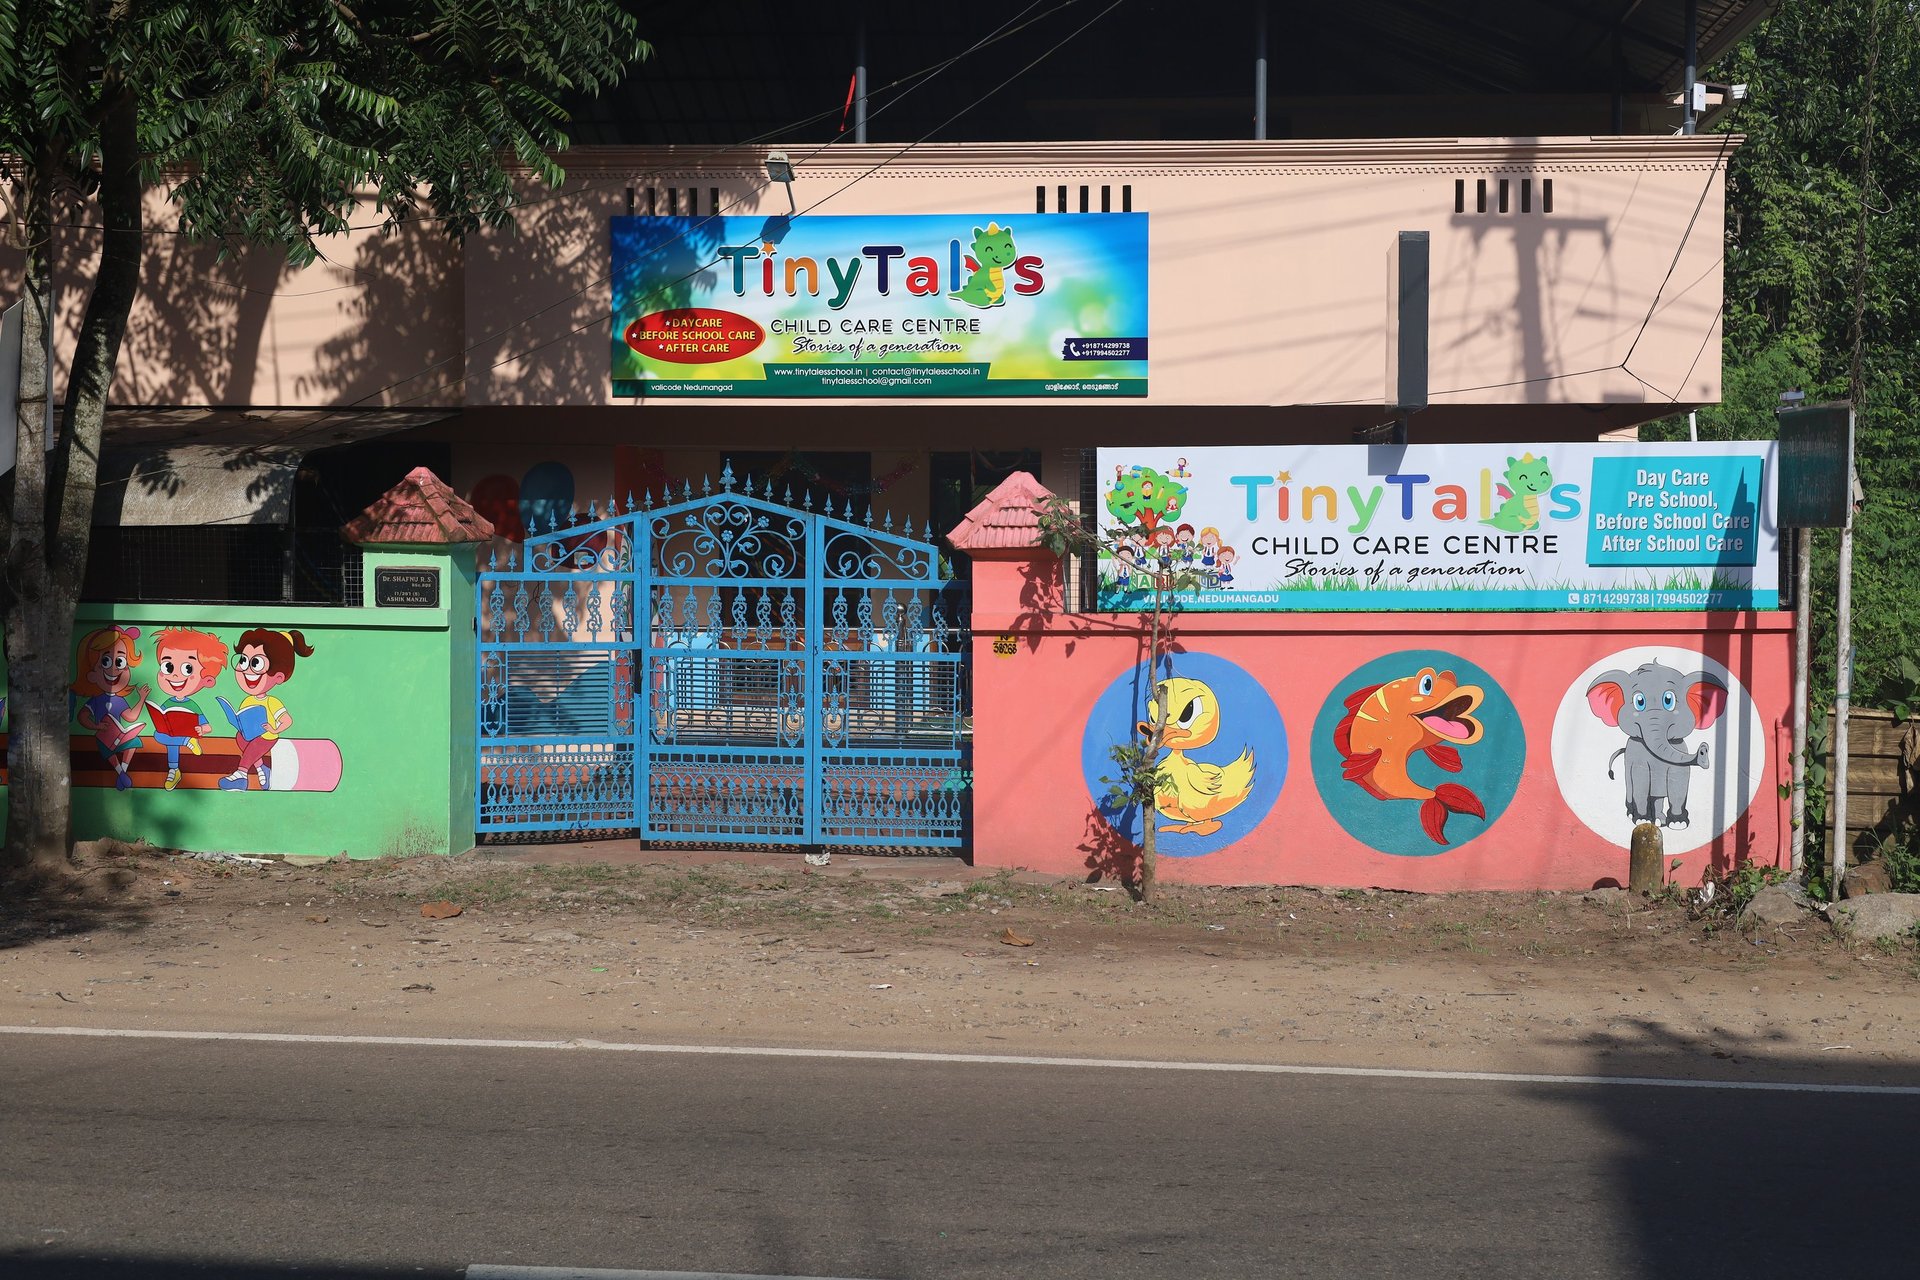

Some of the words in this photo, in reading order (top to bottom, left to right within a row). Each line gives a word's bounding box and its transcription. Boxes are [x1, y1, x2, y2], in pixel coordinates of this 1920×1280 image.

[717, 238, 1045, 310] TinyTals
[672, 318, 723, 328] DAYCARE
[770, 319, 832, 334] CHILD
[841, 319, 893, 333] CARE
[902, 319, 981, 333] CENTRE
[639, 331, 679, 341] BEFORE
[682, 331, 725, 341] SCHOOL
[728, 331, 756, 340] CARE
[665, 343, 699, 353] AFTER
[702, 343, 730, 353] CARE
[792, 337, 845, 353] Stories
[848, 337, 867, 361] of
[867, 343, 876, 351] a
[878, 337, 961, 358] generation
[774, 367, 863, 376] www.tinytalesschool.in
[872, 367, 981, 376] contact@tinytalesschool.in
[683, 384, 733, 392] Nedumangad
[822, 377, 932, 386] tinytalesschool@gmail.com
[1636, 470, 1667, 488] Day
[1671, 469, 1709, 486] Care
[1230, 467, 1583, 534] TinyTals
[1627, 492, 1656, 508] Pre
[1659, 491, 1719, 510] School,
[1595, 513, 1649, 530] Before
[1653, 512, 1708, 530] School
[1712, 513, 1750, 530] Care
[1252, 536, 1339, 555] CHILD
[1353, 536, 1430, 554] CARE
[1443, 535, 1559, 554] CENTRE
[1601, 535, 1642, 552] After
[1646, 534, 1702, 552] School
[1705, 534, 1744, 551] Care
[1284, 558, 1359, 578] Stories
[1363, 560, 1387, 586] of
[1388, 567, 1402, 577] a
[1407, 560, 1526, 584] generation
[1143, 594, 1280, 604] VAIODE,NEDUMANGADU
[1583, 593, 1650, 605] 8714299738
[1656, 593, 1723, 605] 7994502277
